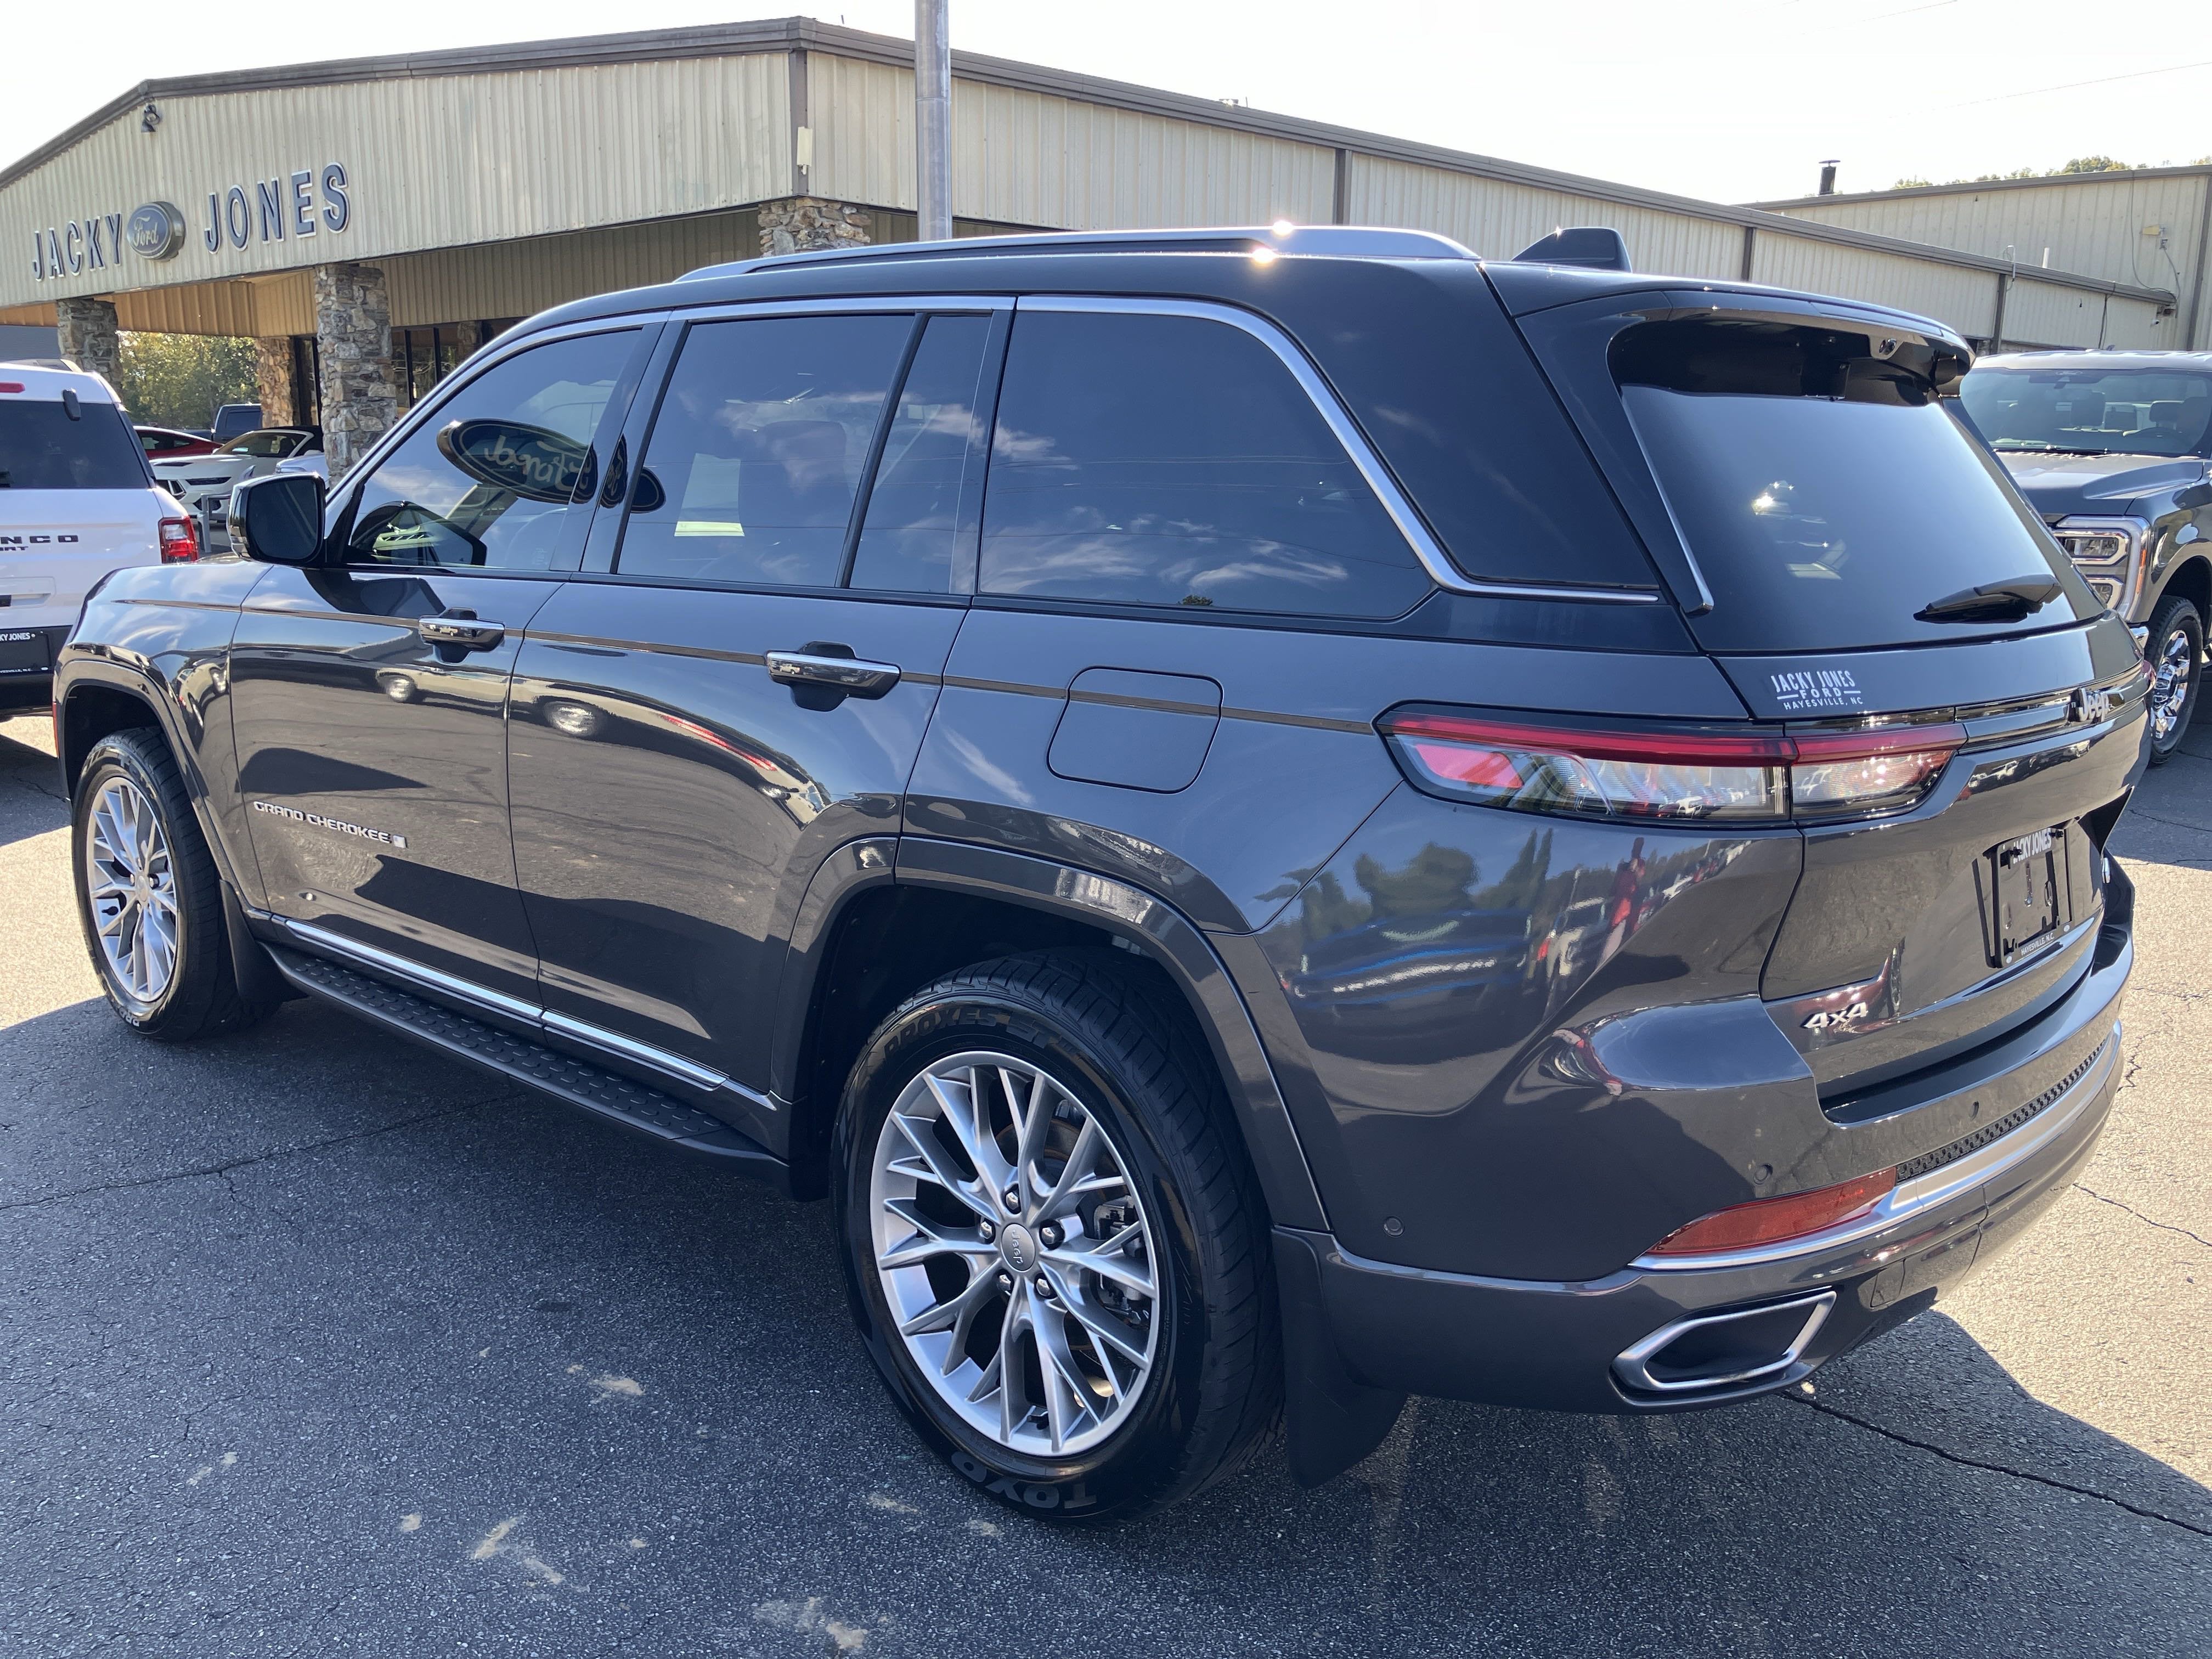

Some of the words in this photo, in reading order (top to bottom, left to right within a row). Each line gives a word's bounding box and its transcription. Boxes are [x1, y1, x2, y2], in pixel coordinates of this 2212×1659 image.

[32, 211, 122, 282] JACKY
[204, 162, 350, 255] JONES
[0, 535, 78, 544] NCO
[8, 632, 31, 641] JONES
[1771, 672, 1815, 692] JACKY
[1816, 670, 1855, 688] JONES
[1799, 687, 1842, 699] FORD
[1783, 697, 1848, 710] HAYESVILLE,
[2078, 687, 2109, 722] Jeep
[253, 800, 306, 821] GRAND
[306, 814, 392, 844] CHEROKEE
[2032, 828, 2052, 855] JONES
[883, 1006, 997, 1062] PROXES
[1011, 1229, 1024, 1264] Jeep
[950, 1451, 1098, 1509] TOYO
